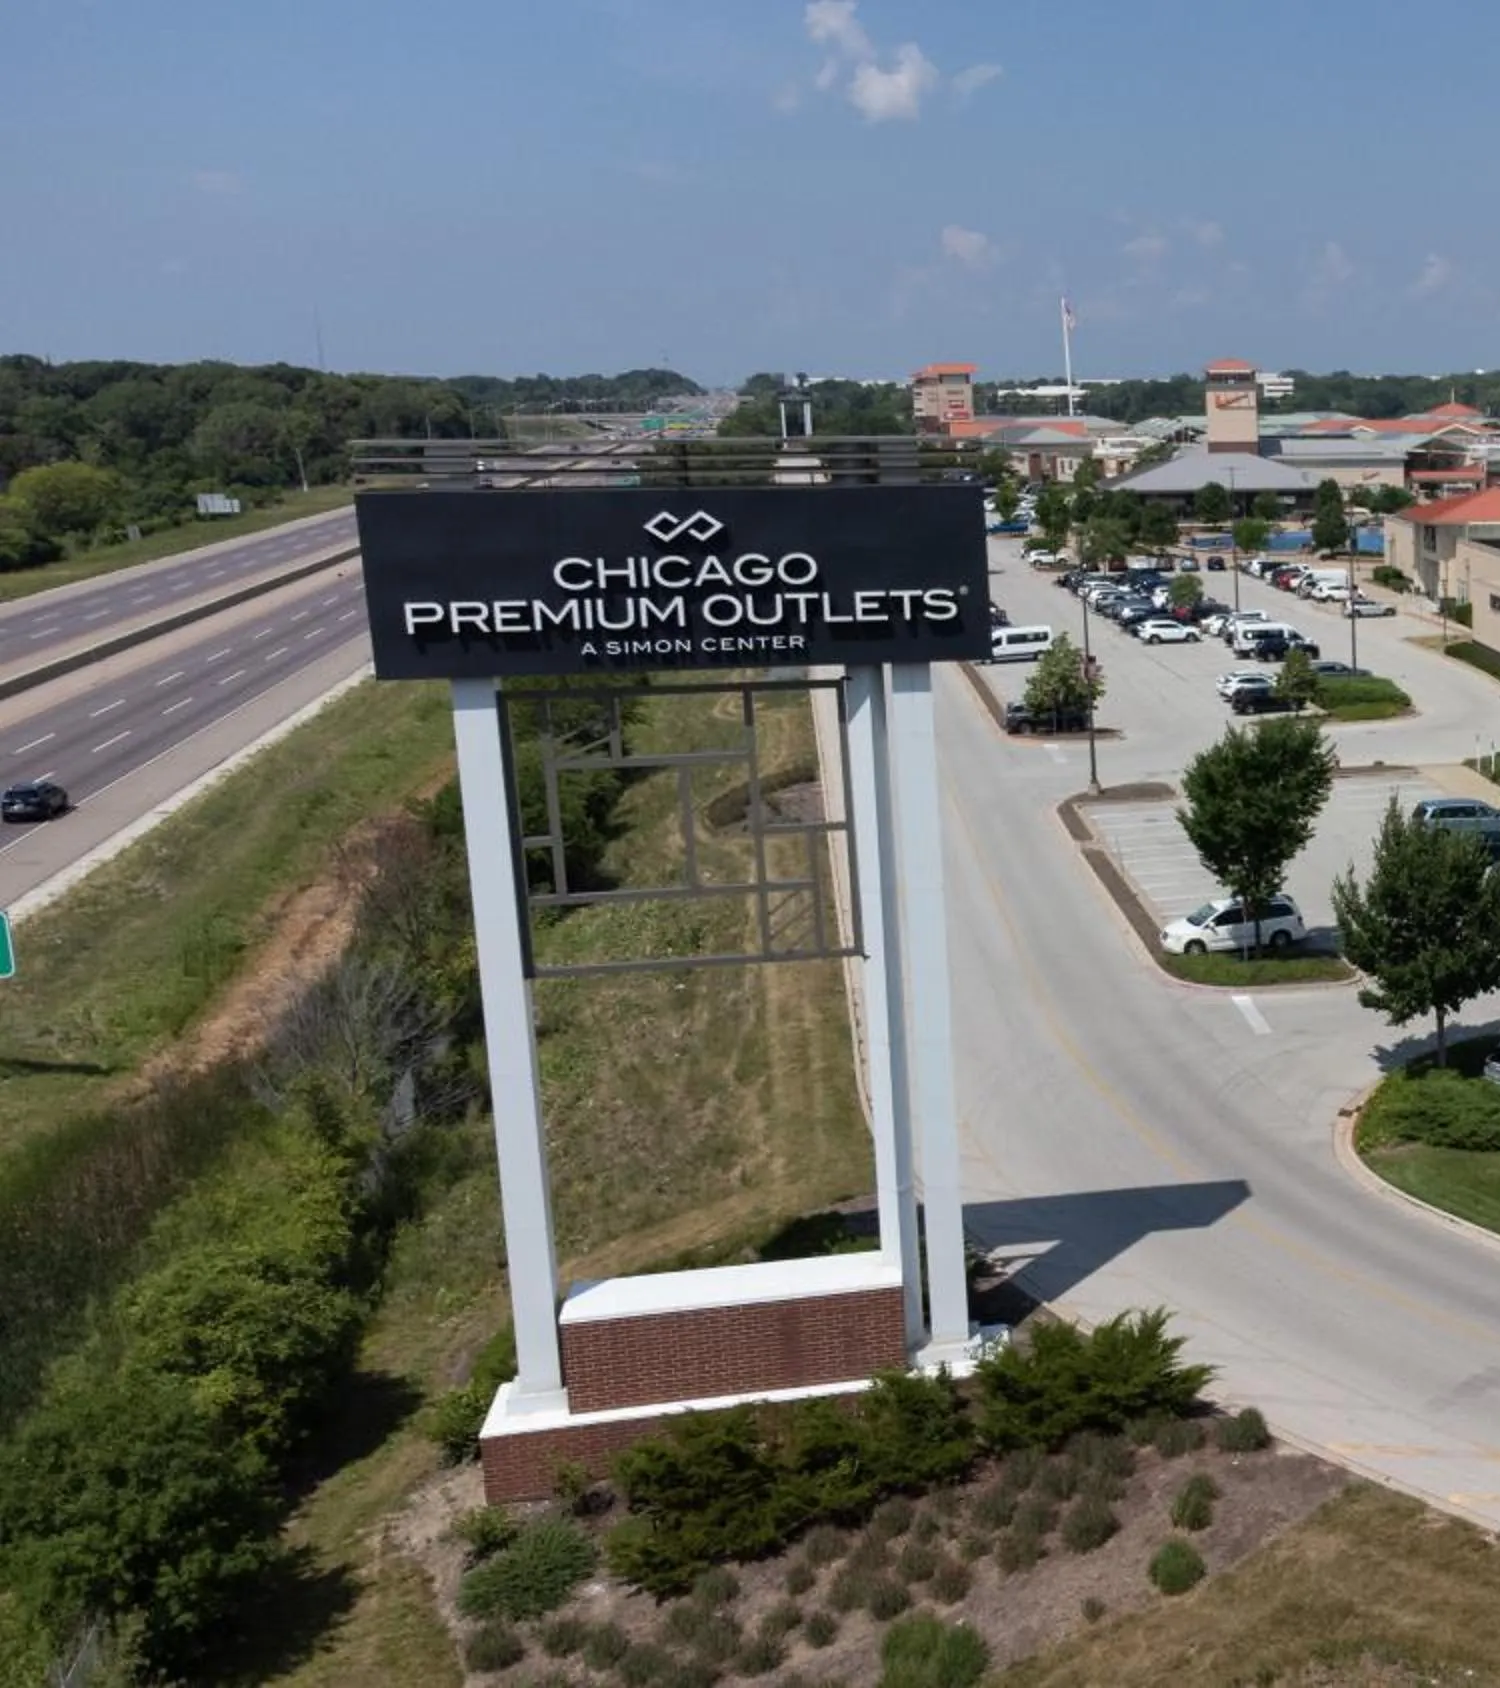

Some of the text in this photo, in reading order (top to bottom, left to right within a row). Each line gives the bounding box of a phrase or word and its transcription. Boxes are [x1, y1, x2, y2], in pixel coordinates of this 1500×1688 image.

[553, 553, 818, 590] CHICAGO
[403, 596, 687, 634] PREMIUM
[581, 635, 806, 656] A SIMON CENTER
